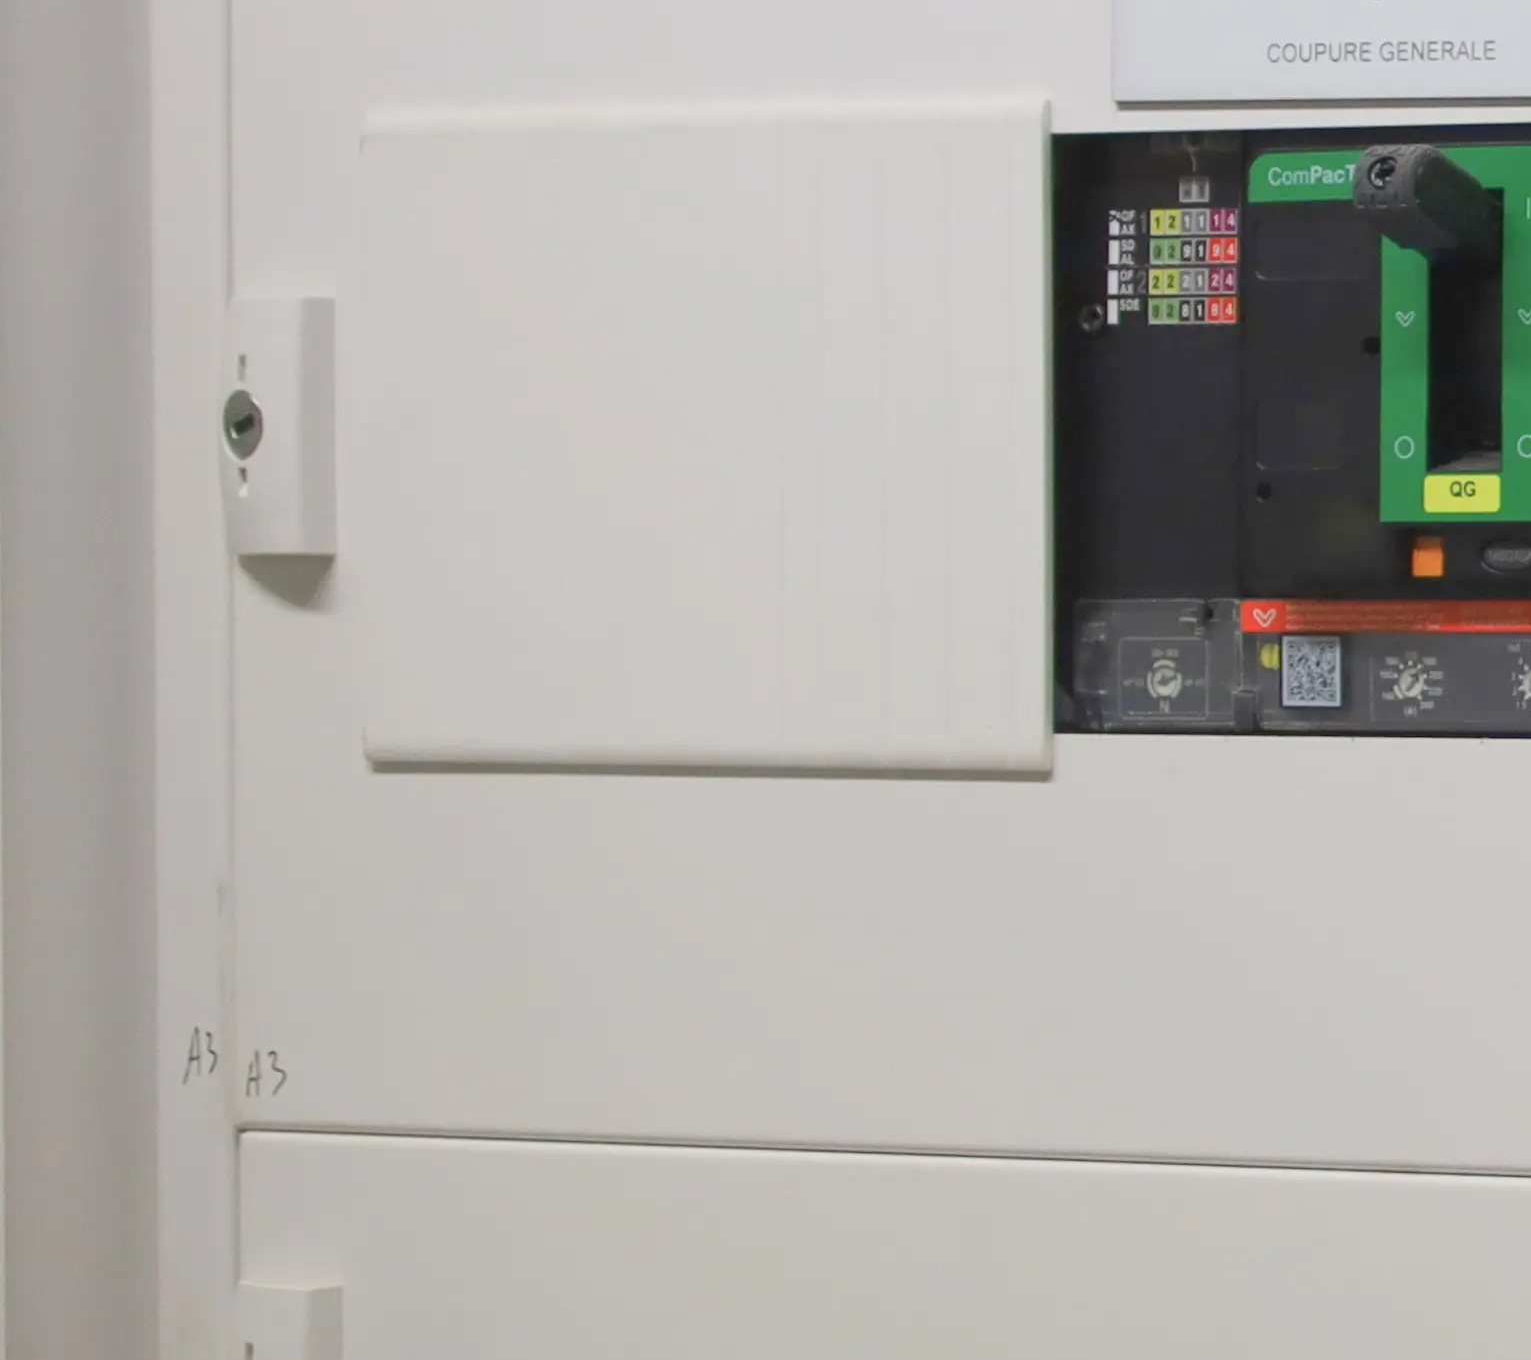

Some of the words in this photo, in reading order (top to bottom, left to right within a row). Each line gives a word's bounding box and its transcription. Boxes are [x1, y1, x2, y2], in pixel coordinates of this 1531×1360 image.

[1267, 41, 1372, 64] COUPURE
[1379, 40, 1497, 63] GENERALE
[1449, 480, 1476, 498] QG
[182, 1023, 219, 1087] A3
[245, 1049, 287, 1098] A3
